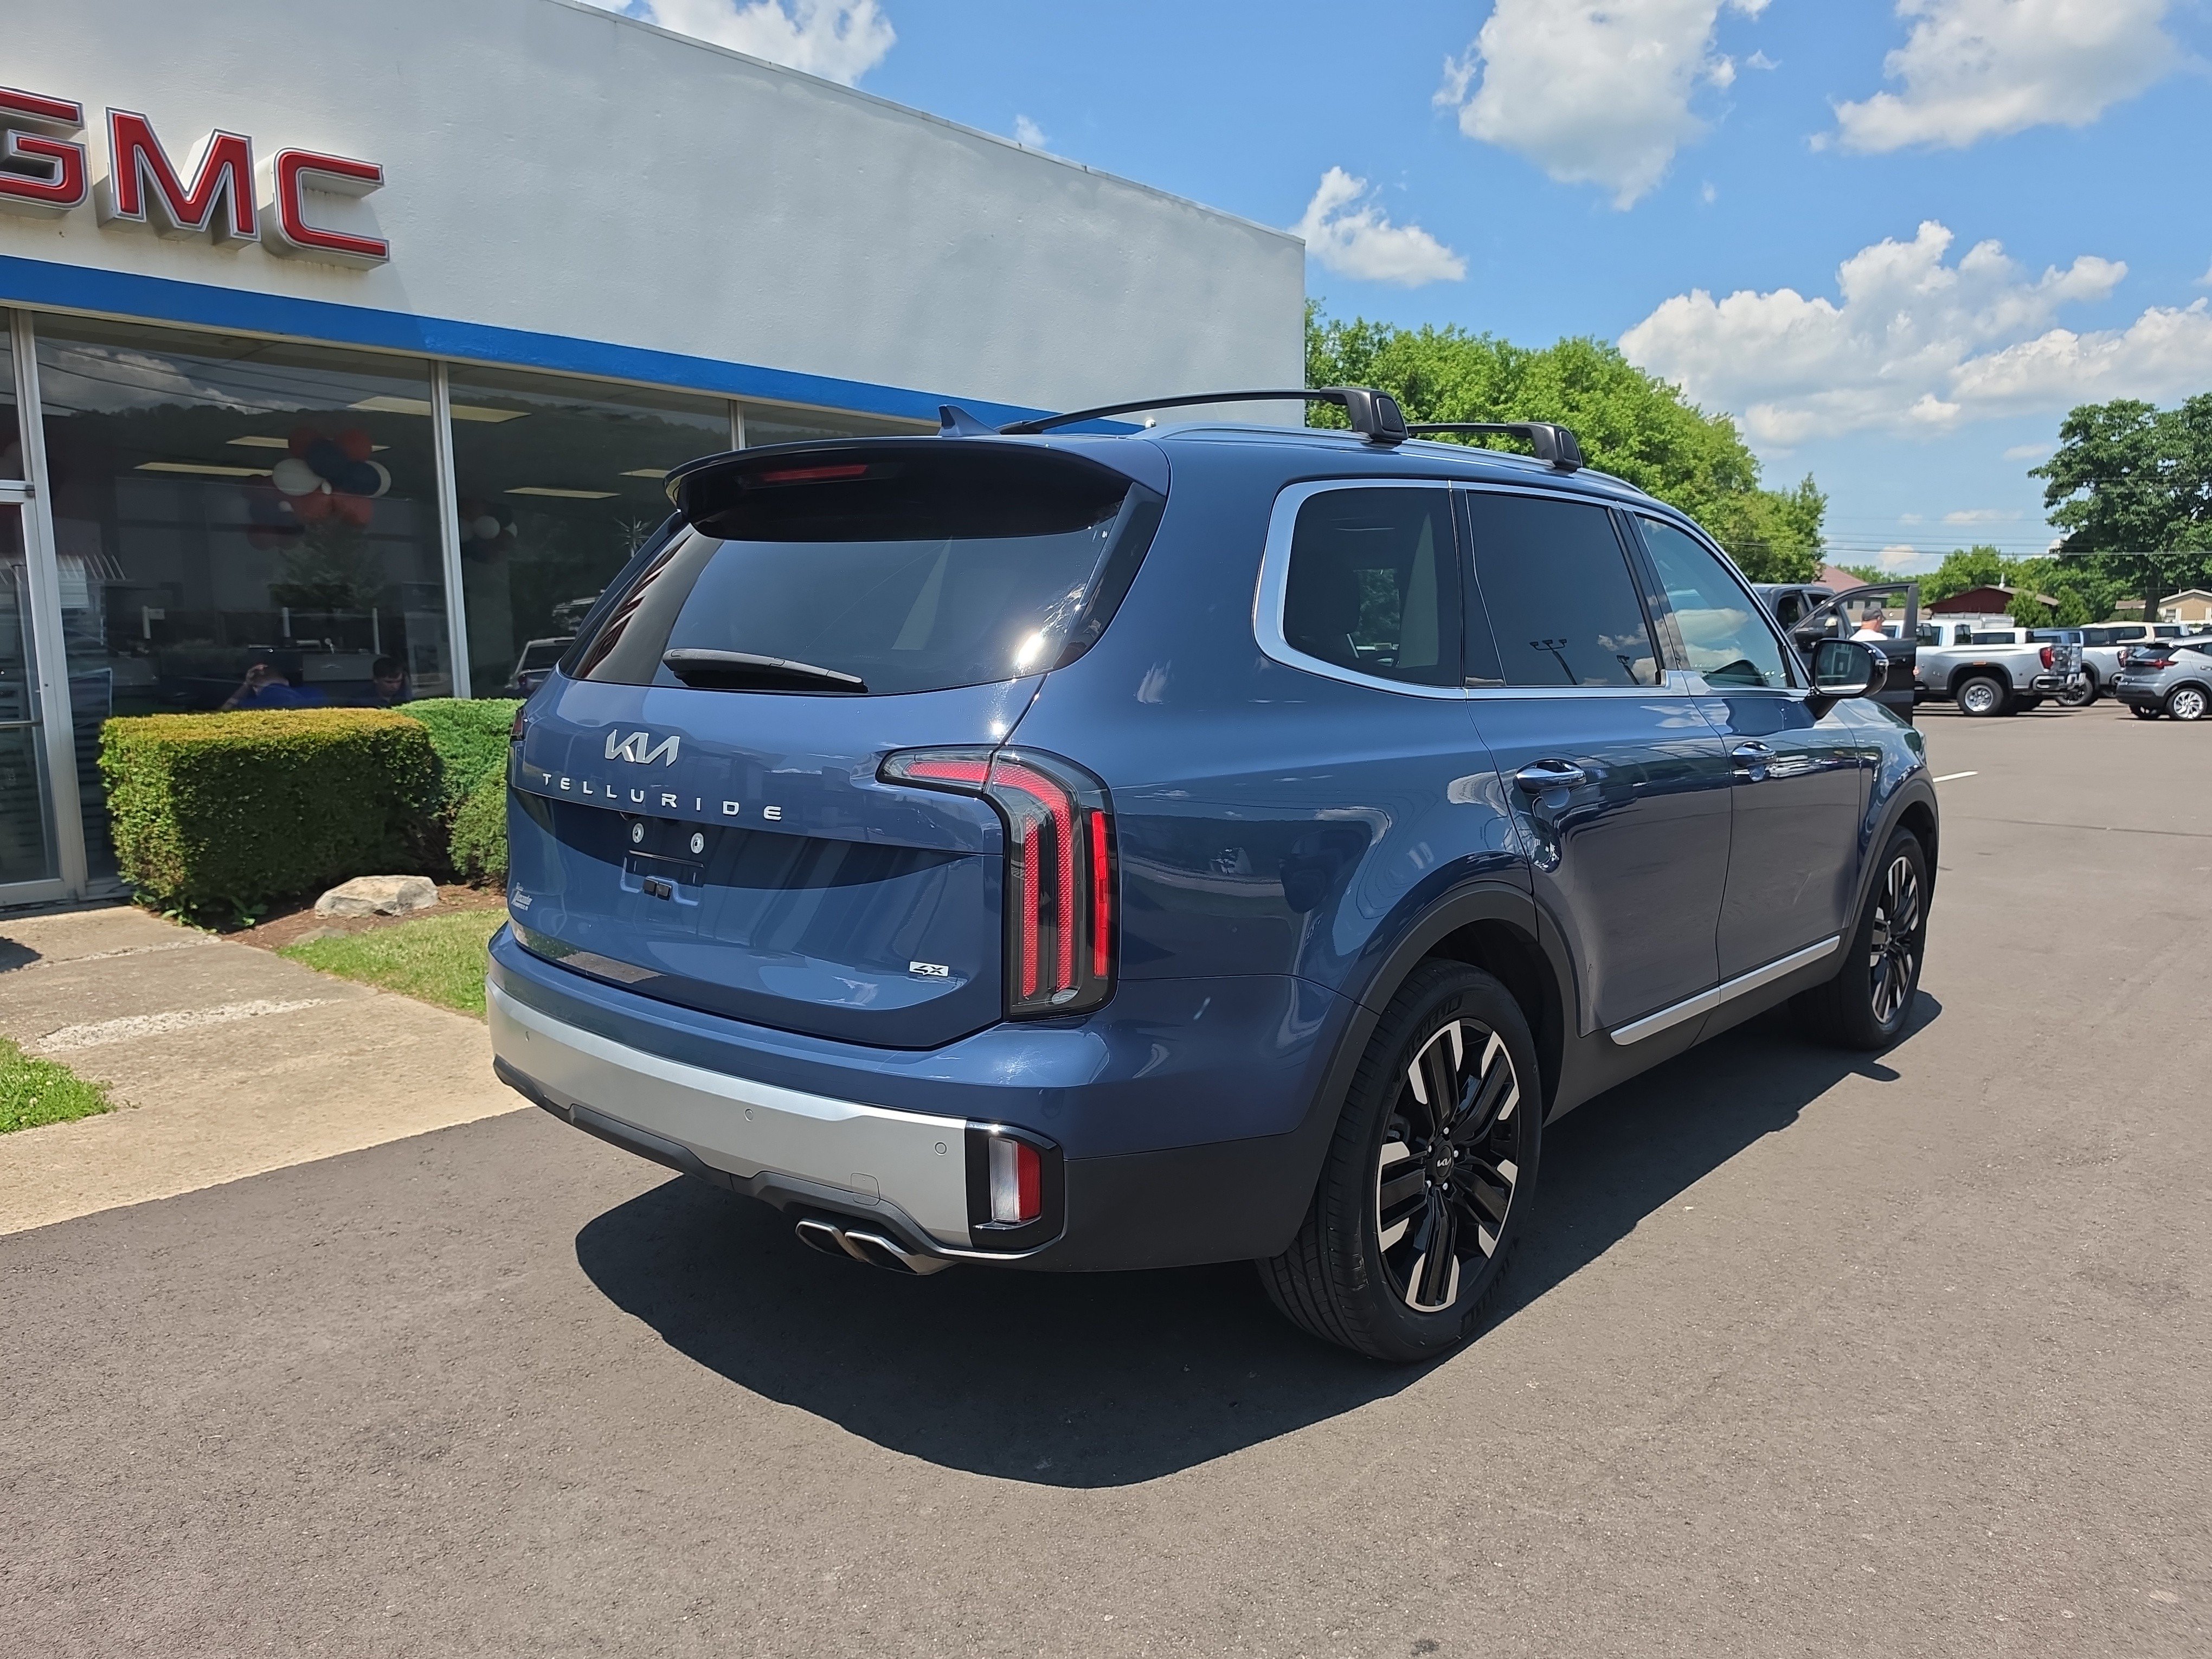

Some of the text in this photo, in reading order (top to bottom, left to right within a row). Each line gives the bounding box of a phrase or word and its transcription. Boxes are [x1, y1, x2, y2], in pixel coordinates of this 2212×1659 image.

[0, 86, 390, 263] GMC
[605, 729, 680, 767] KIA
[543, 773, 782, 821] TELLURIDE
